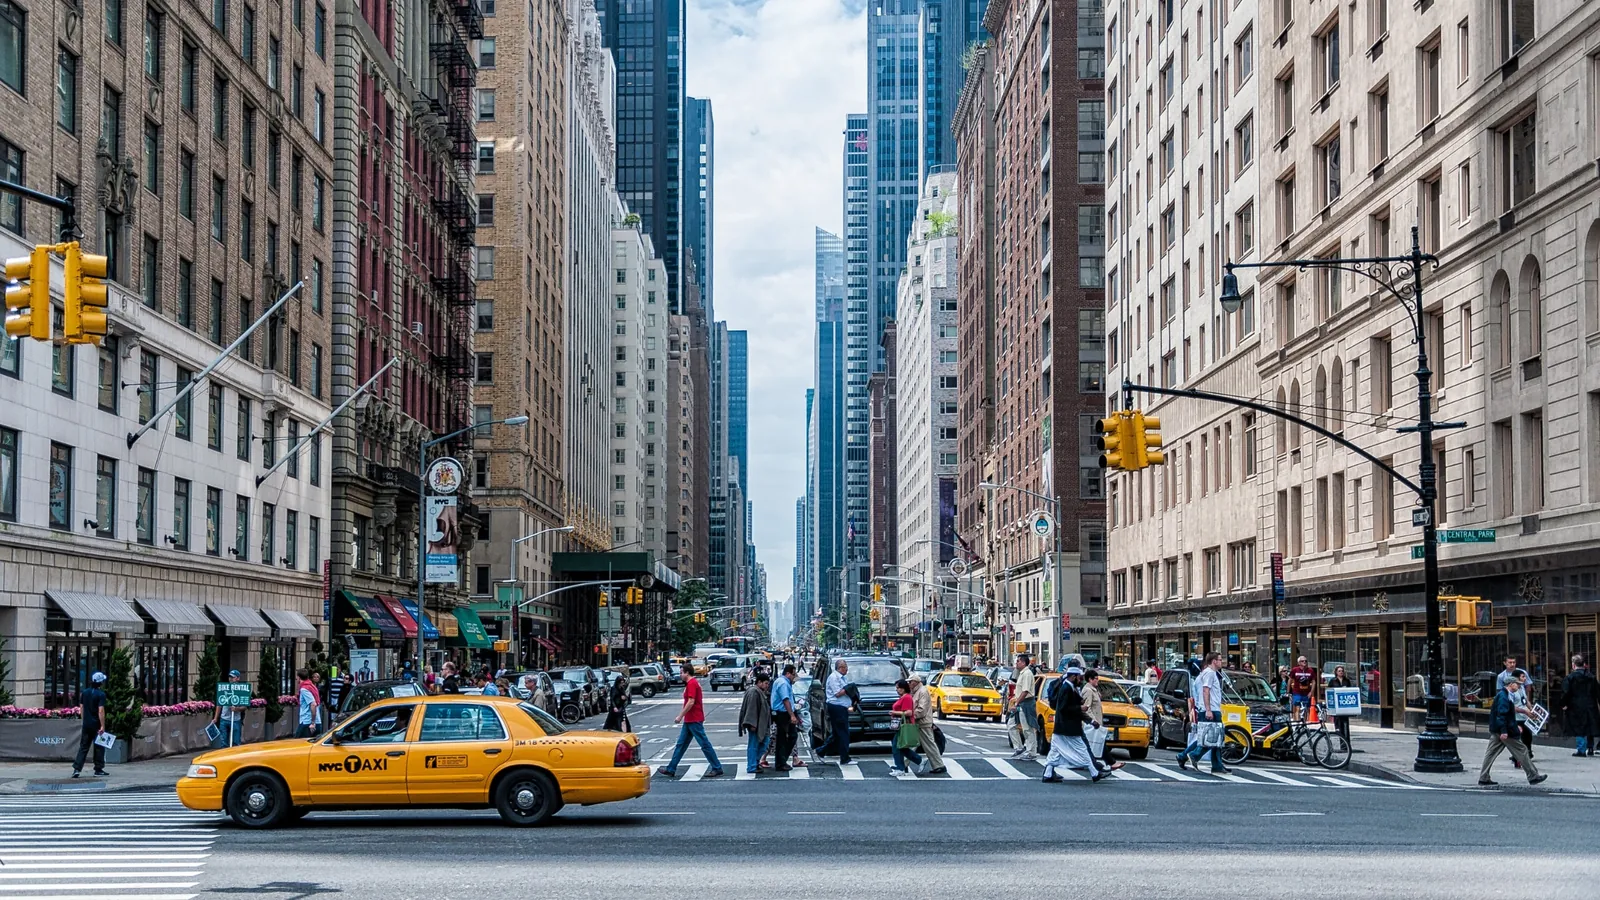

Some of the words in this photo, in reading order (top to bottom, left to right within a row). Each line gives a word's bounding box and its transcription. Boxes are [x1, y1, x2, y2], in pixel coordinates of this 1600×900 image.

[1447, 530, 1475, 539] CENTRAL
[1478, 530, 1494, 538] PARK
[230, 684, 250, 692] RENTAL
[34, 736, 66, 745] MARKET
[318, 762, 343, 772] NYC
[343, 755, 388, 773] TAXI
